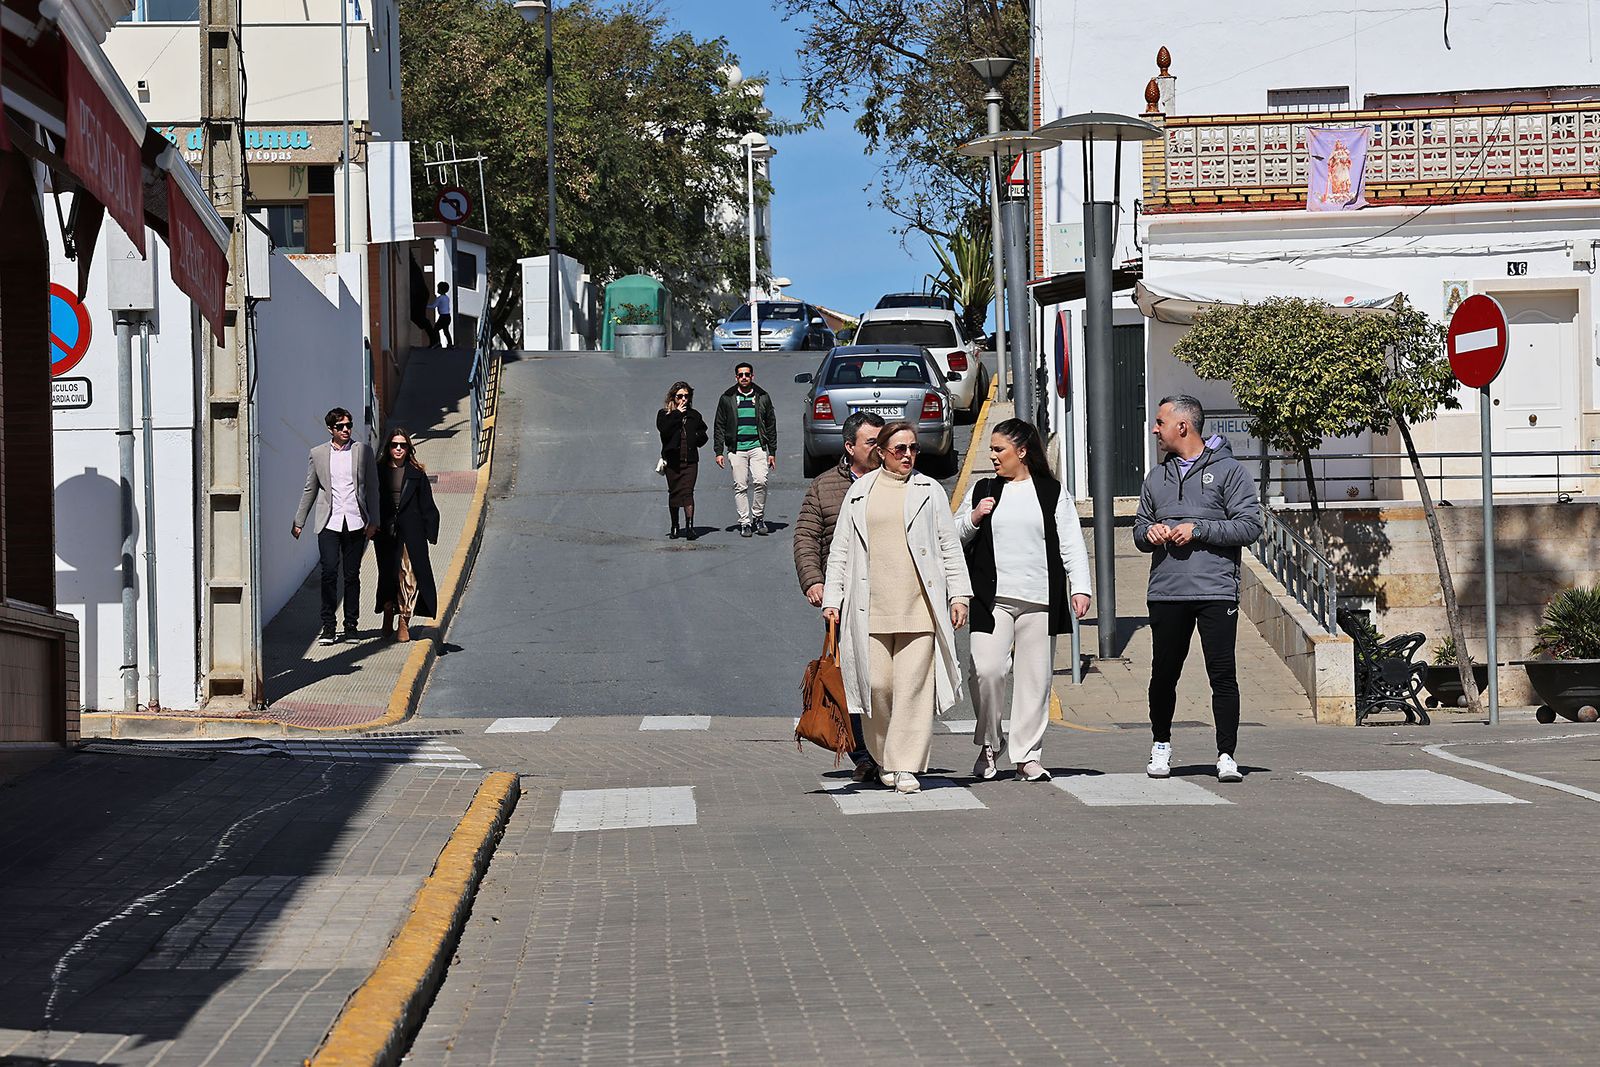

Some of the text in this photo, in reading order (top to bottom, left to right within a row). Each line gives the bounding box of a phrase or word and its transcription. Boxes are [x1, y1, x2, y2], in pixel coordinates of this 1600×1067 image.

[256, 151, 292, 162] Copas
[71, 394, 87, 403] CIVIL
[882, 406, 899, 415] CKS
[1217, 420, 1249, 433] HIELO
